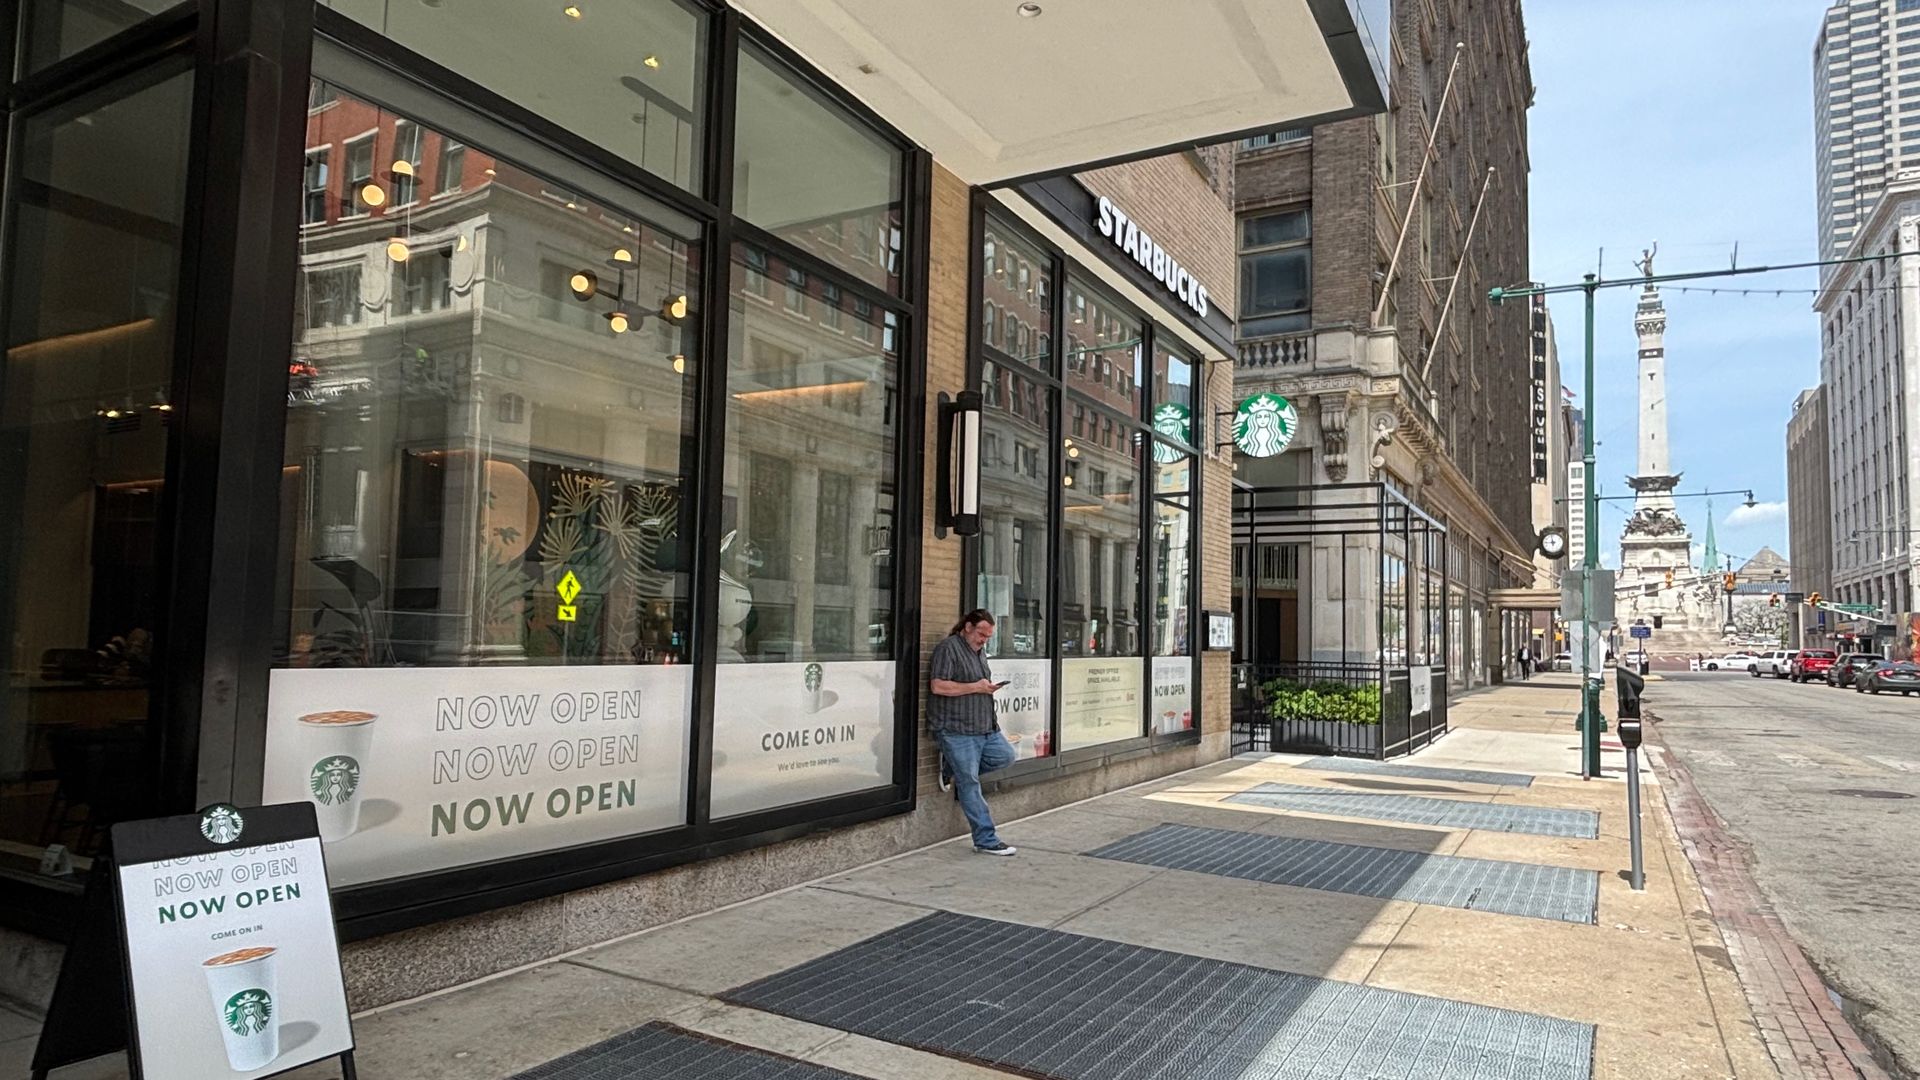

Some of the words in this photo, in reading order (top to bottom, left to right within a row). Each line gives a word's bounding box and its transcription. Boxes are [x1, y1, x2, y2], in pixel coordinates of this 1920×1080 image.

[1098, 195, 1208, 318] STARBUCKS
[1012, 672, 1041, 690] OPEN
[1154, 684, 1169, 697] NOW
[1170, 683, 1186, 696] OPEN
[436, 693, 540, 732] NOW
[550, 689, 642, 724] OPEN
[993, 697, 1011, 714] OW
[1012, 695, 1040, 713] OPEN
[761, 729, 810, 752] COME
[814, 726, 836, 745] ON
[840, 724, 855, 742] IN
[432, 742, 538, 785] NOW
[548, 733, 639, 772] OPEN
[777, 760, 795, 772] We'd
[795, 760, 809, 769] love
[809, 759, 817, 767] to
[817, 758, 828, 766] see
[431, 791, 535, 837] NOW
[546, 778, 636, 819] OPEN
[154, 868, 223, 897] NOW
[231, 857, 298, 884] OPEN
[158, 895, 226, 924] NOW
[235, 882, 301, 909] OPEN
[211, 929, 237, 941] COME
[238, 926, 252, 935] ON
[253, 924, 264, 932] IN
